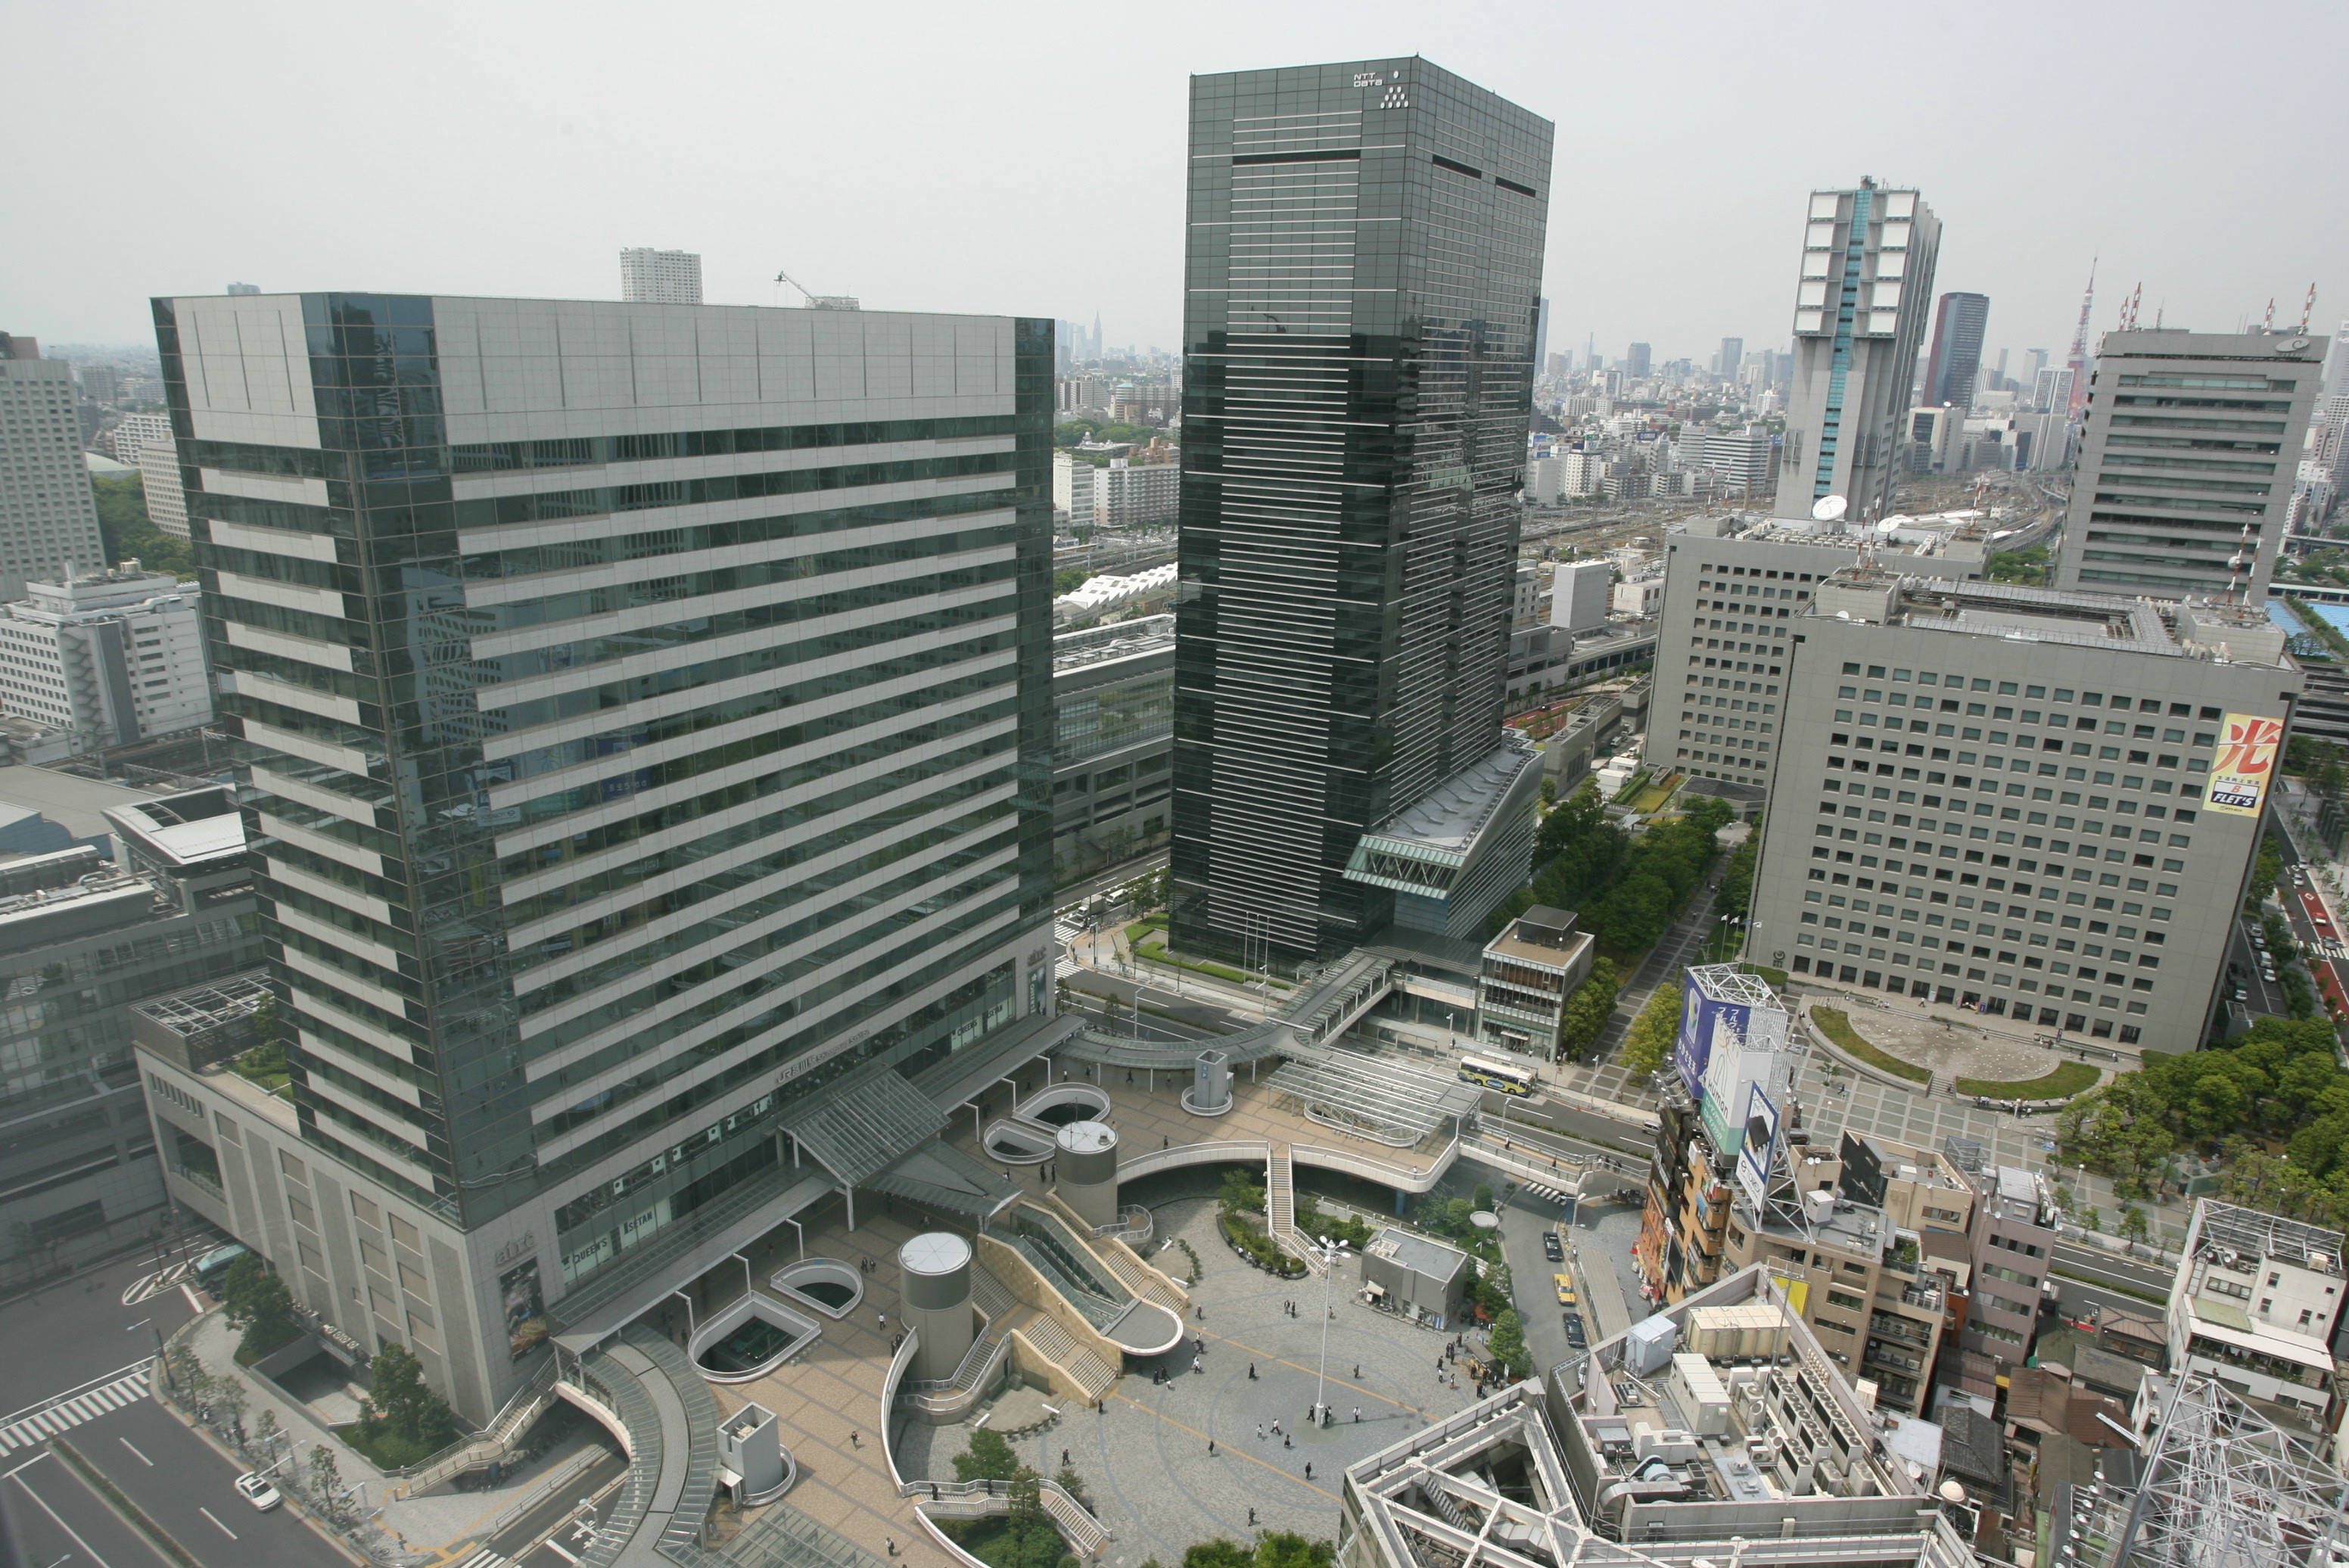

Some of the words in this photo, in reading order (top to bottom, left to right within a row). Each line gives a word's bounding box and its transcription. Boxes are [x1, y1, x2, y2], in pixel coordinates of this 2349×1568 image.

[1354, 72, 1376, 80] NTT
[1354, 79, 1383, 87] DATA
[2211, 719, 2282, 774] 光
[2231, 785, 2242, 793] B
[2213, 792, 2255, 806] FLET'S
[573, 1237, 608, 1265] QUEEN'S
[624, 1211, 653, 1235] ISETAN
